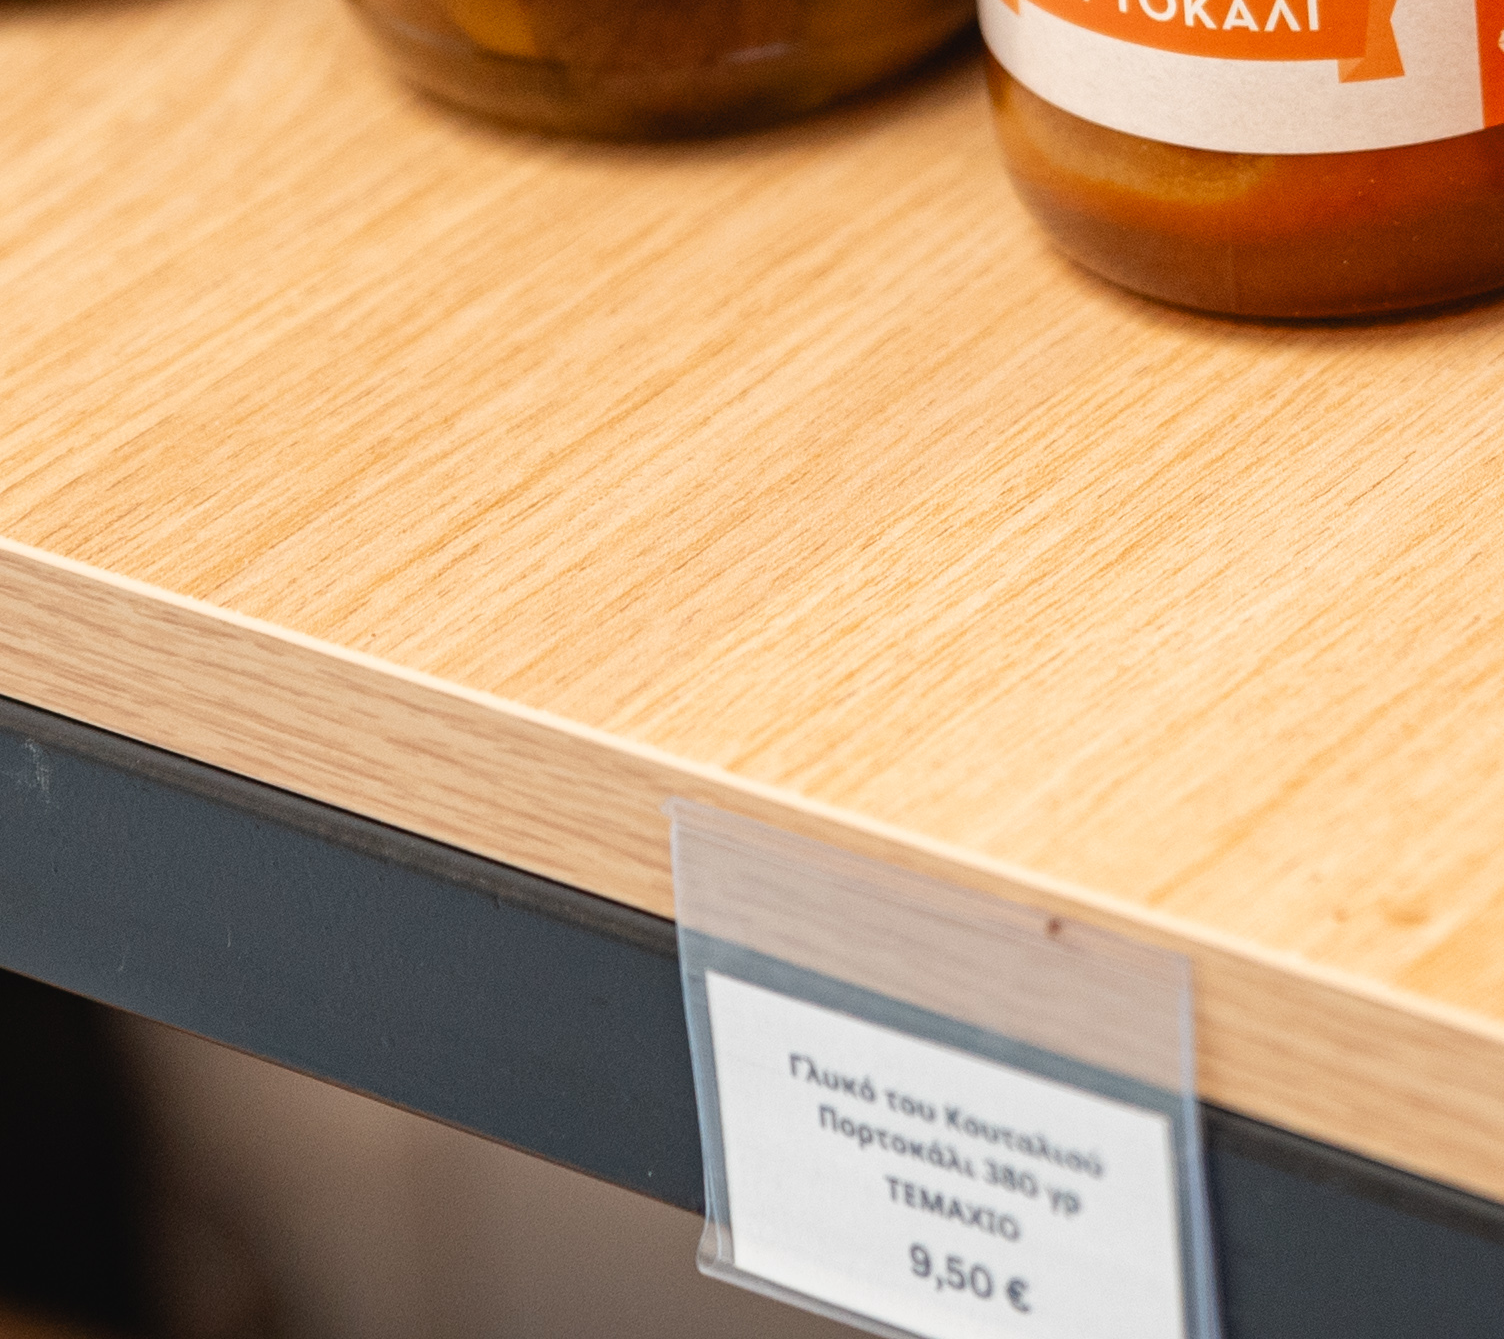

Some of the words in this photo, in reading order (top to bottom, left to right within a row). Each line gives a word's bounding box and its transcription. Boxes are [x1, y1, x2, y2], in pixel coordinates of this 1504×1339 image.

[788, 1051, 879, 1106] Γλυκό
[884, 1088, 937, 1125] του
[943, 1102, 1107, 1180] Κουταλιού
[817, 1104, 977, 1180] Πορτοκάλι
[984, 1160, 1040, 1200] 380
[1044, 1183, 1085, 1221] γρ
[885, 1173, 1023, 1244] ΤΕΜΑΧΙΟ
[908, 1240, 996, 1302] 9,50
[1004, 1275, 1034, 1315] €
